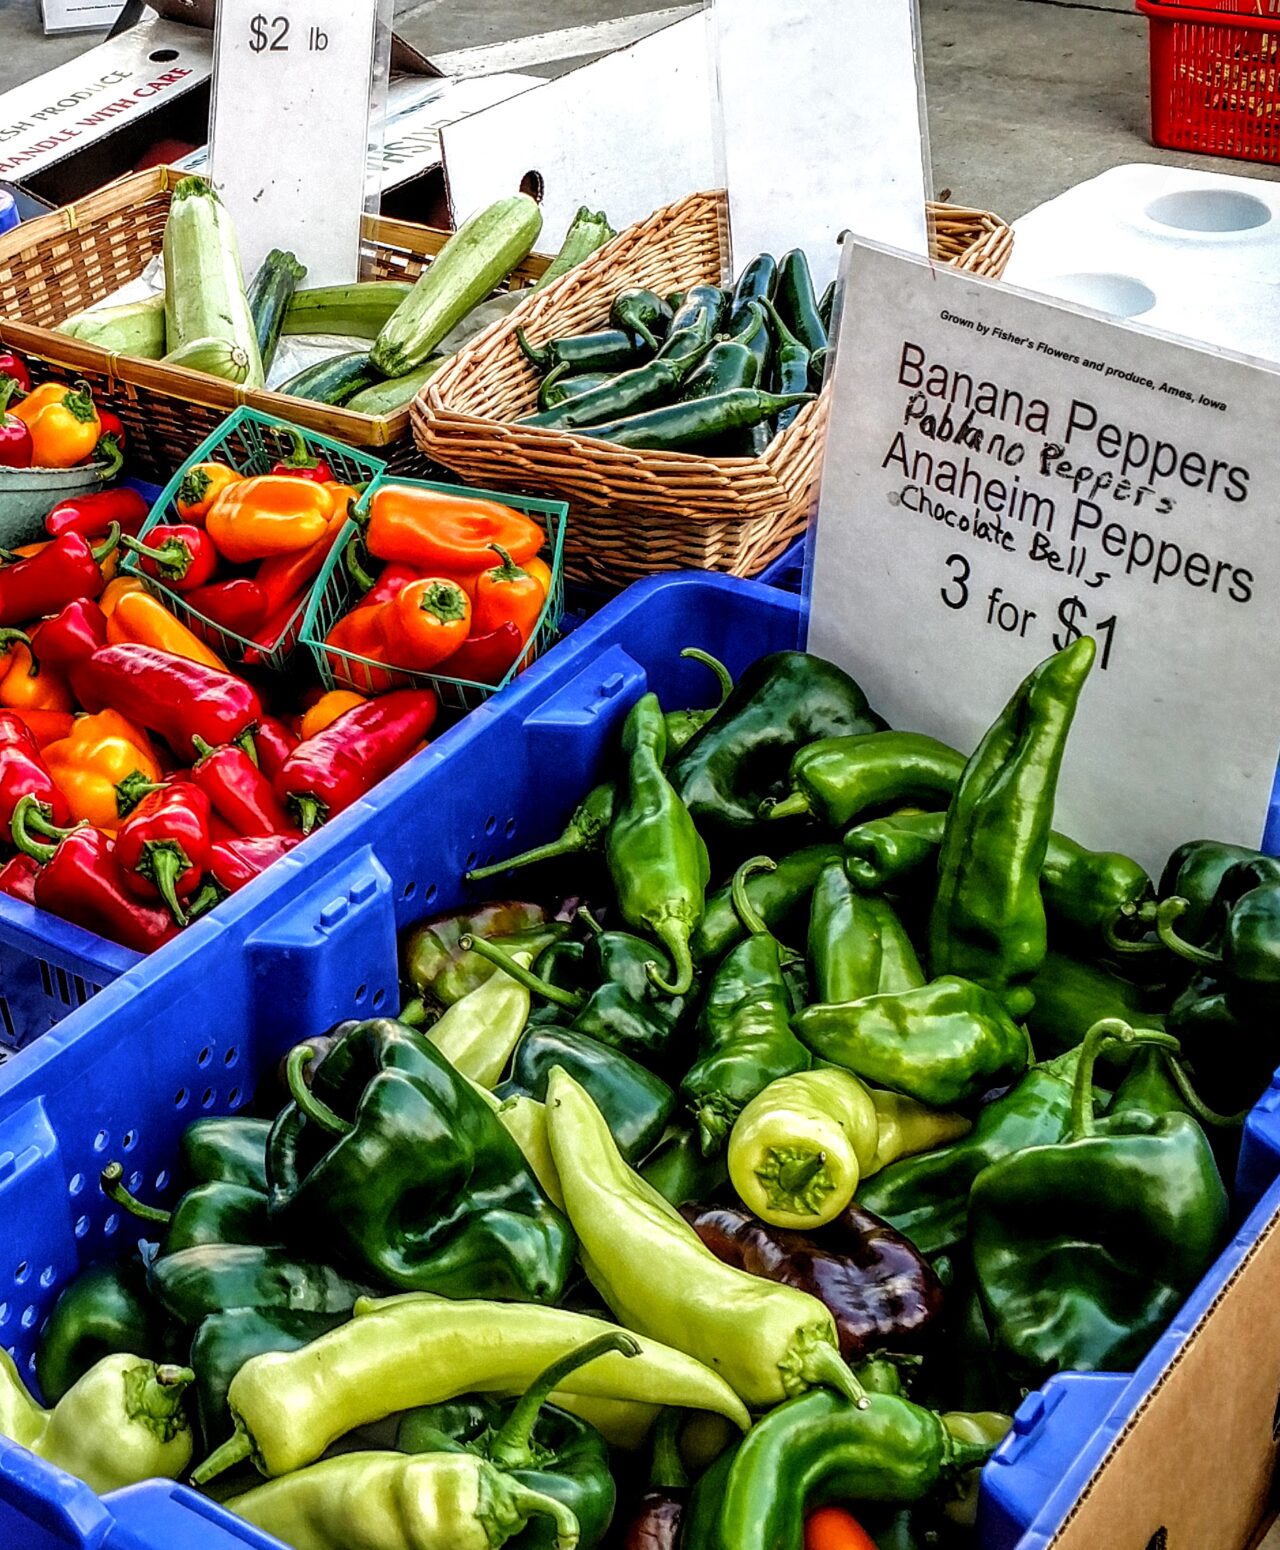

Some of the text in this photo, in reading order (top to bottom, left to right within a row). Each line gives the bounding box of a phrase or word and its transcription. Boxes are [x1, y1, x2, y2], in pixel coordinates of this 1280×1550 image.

[249, 14, 329, 54] $2 lb
[30, 70, 134, 122] PRODUCE
[76, 98, 138, 128] WITH
[133, 66, 195, 98] CARE
[940, 309, 1228, 412] Grown by Fisher's Flowers and produce, Ames, Iowa
[898, 341, 1251, 503] Banana Peppers
[881, 431, 1256, 604] Anaheim Peppers
[1039, 441, 1177, 514] Peppers
[900, 485, 1112, 588] Chocolate Bells
[941, 553, 1117, 670] 3 for $1
